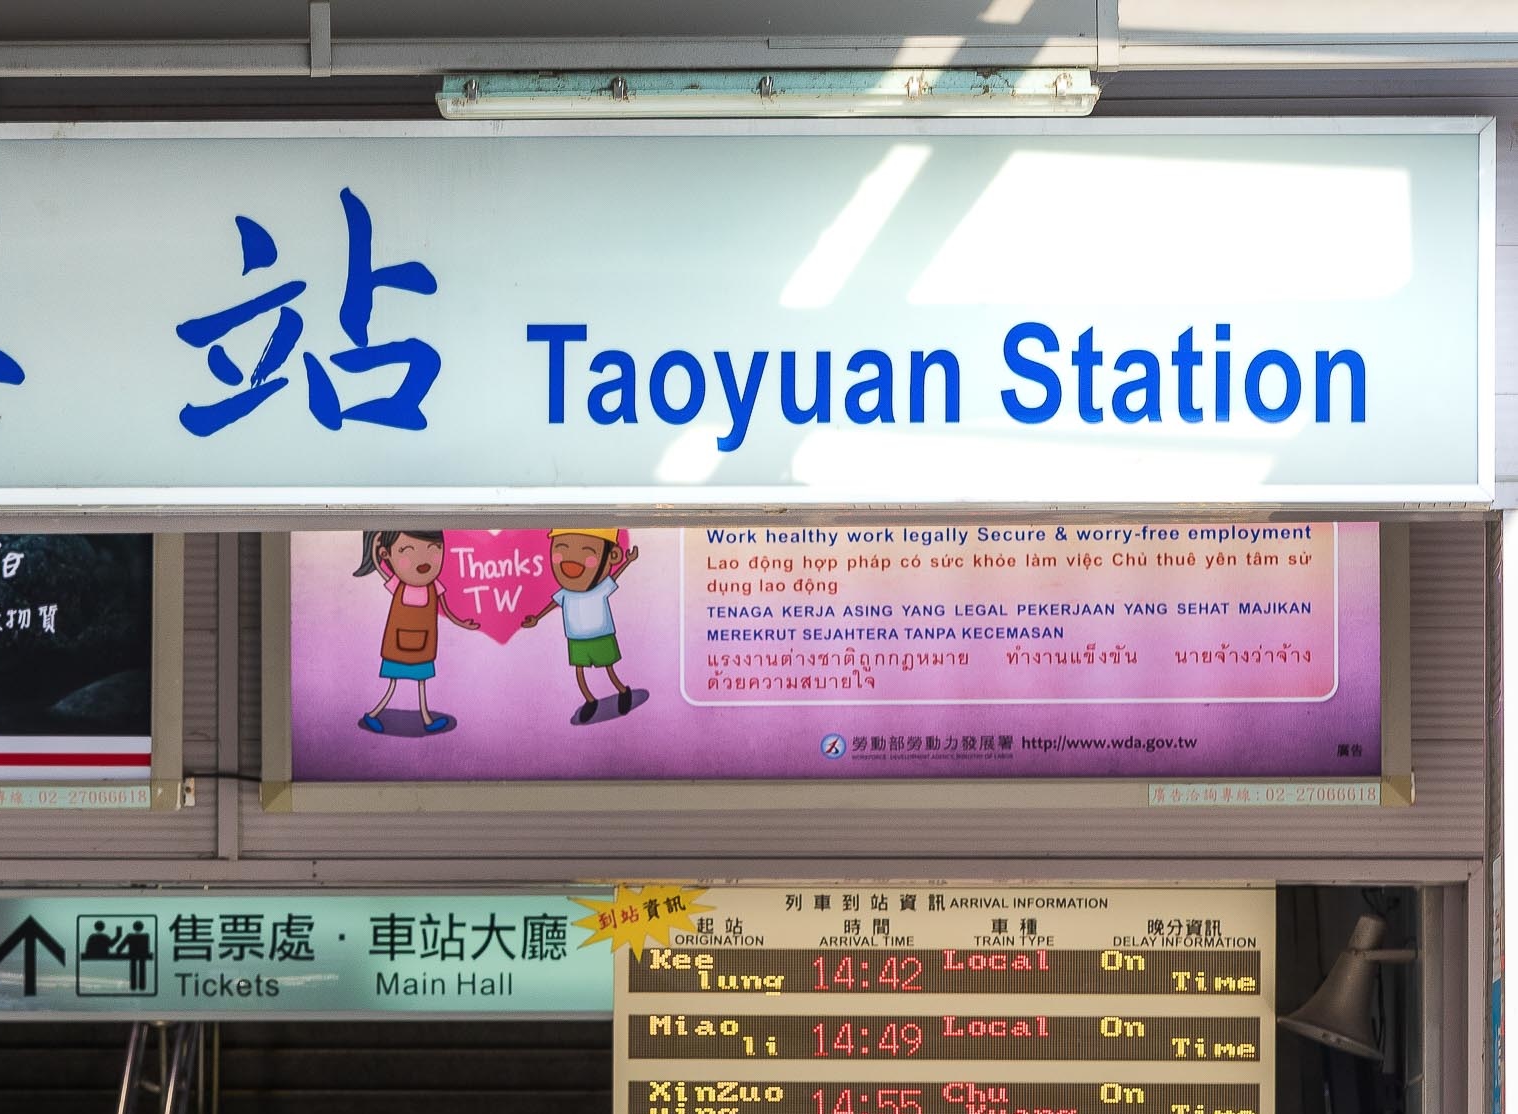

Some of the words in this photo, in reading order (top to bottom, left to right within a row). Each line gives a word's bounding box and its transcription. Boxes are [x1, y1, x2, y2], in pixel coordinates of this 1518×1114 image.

[526, 323, 960, 453] Taoyuan
[999, 320, 1368, 424] Station
[707, 529, 757, 544] Work
[766, 528, 838, 546] healthy
[847, 529, 894, 543] work
[903, 527, 968, 545] legally
[978, 526, 1046, 543] Secure
[1055, 526, 1068, 542] &
[1076, 526, 1179, 544] worry-free
[1188, 525, 1312, 544] employment
[450, 547, 544, 580] Thanks
[707, 556, 739, 570] Lao
[749, 556, 793, 573] động
[803, 555, 838, 572] hợp
[847, 555, 892, 572] pháp
[900, 555, 921, 569] có
[1157, 551, 1196, 566] thuê
[1205, 551, 1237, 569] yên
[1246, 551, 1279, 566] tâm
[707, 579, 752, 595] dụng
[760, 579, 786, 592] lao
[793, 579, 838, 595] động
[463, 585, 523, 614] TW
[707, 605, 773, 618] TENAGA
[782, 605, 835, 618] KERJA
[843, 604, 893, 617] ASING
[902, 604, 945, 617] YANG
[955, 604, 1008, 617] LEGAL
[1017, 603, 1115, 616] PEKERJAAN
[1124, 602, 1168, 615] YANG
[1177, 602, 1230, 615] SEHAT
[1239, 601, 1312, 615] MAJIKAN
[707, 628, 796, 641] MEREKRUT
[803, 627, 899, 641] SEJAHTERA
[904, 627, 956, 640] TANPA
[962, 626, 1064, 640] KECEMASAN
[1021, 735, 1198, 752] http://www.wda.gov.tw
[1336, 743, 1363, 757] 廣告
[597, 894, 687, 931] 到站資訊
[785, 893, 945, 911] 列車到站資訊
[949, 897, 1009, 909] ARRIVAL
[1013, 897, 1109, 909] INFORMATION
[696, 917, 744, 935] 起站
[843, 918, 891, 936] 時間
[991, 918, 1038, 935] 車種
[1146, 919, 1222, 937] 晚分資訊
[168, 913, 316, 962] 售票處
[369, 913, 569, 962] 車站大廳
[675, 935, 764, 947] ORIGINATION
[819, 936, 878, 947] ARRIVAL
[885, 936, 915, 947] TIME
[974, 936, 1017, 947] TRAIN
[1020, 936, 1055, 947] TYPE
[1113, 936, 1158, 947] DELAY
[1162, 936, 1257, 948] INFORMATION
[649, 948, 715, 970] Kee
[943, 949, 1050, 971] Local
[1100, 950, 1146, 972] On
[813, 955, 923, 991] 14:42
[1171, 971, 1257, 992] Time
[174, 972, 280, 997] Tickets
[376, 971, 447, 996] Main
[457, 971, 514, 996] Hall
[649, 1015, 740, 1036] Miao
[943, 1015, 1050, 1037] Local
[1100, 1016, 1146, 1038] On
[742, 1036, 779, 1056] li
[812, 1022, 923, 1057] 14:49
[1171, 1037, 1256, 1058] Time
[942, 1082, 1009, 1104] Chu
[1100, 1083, 1146, 1105] On
